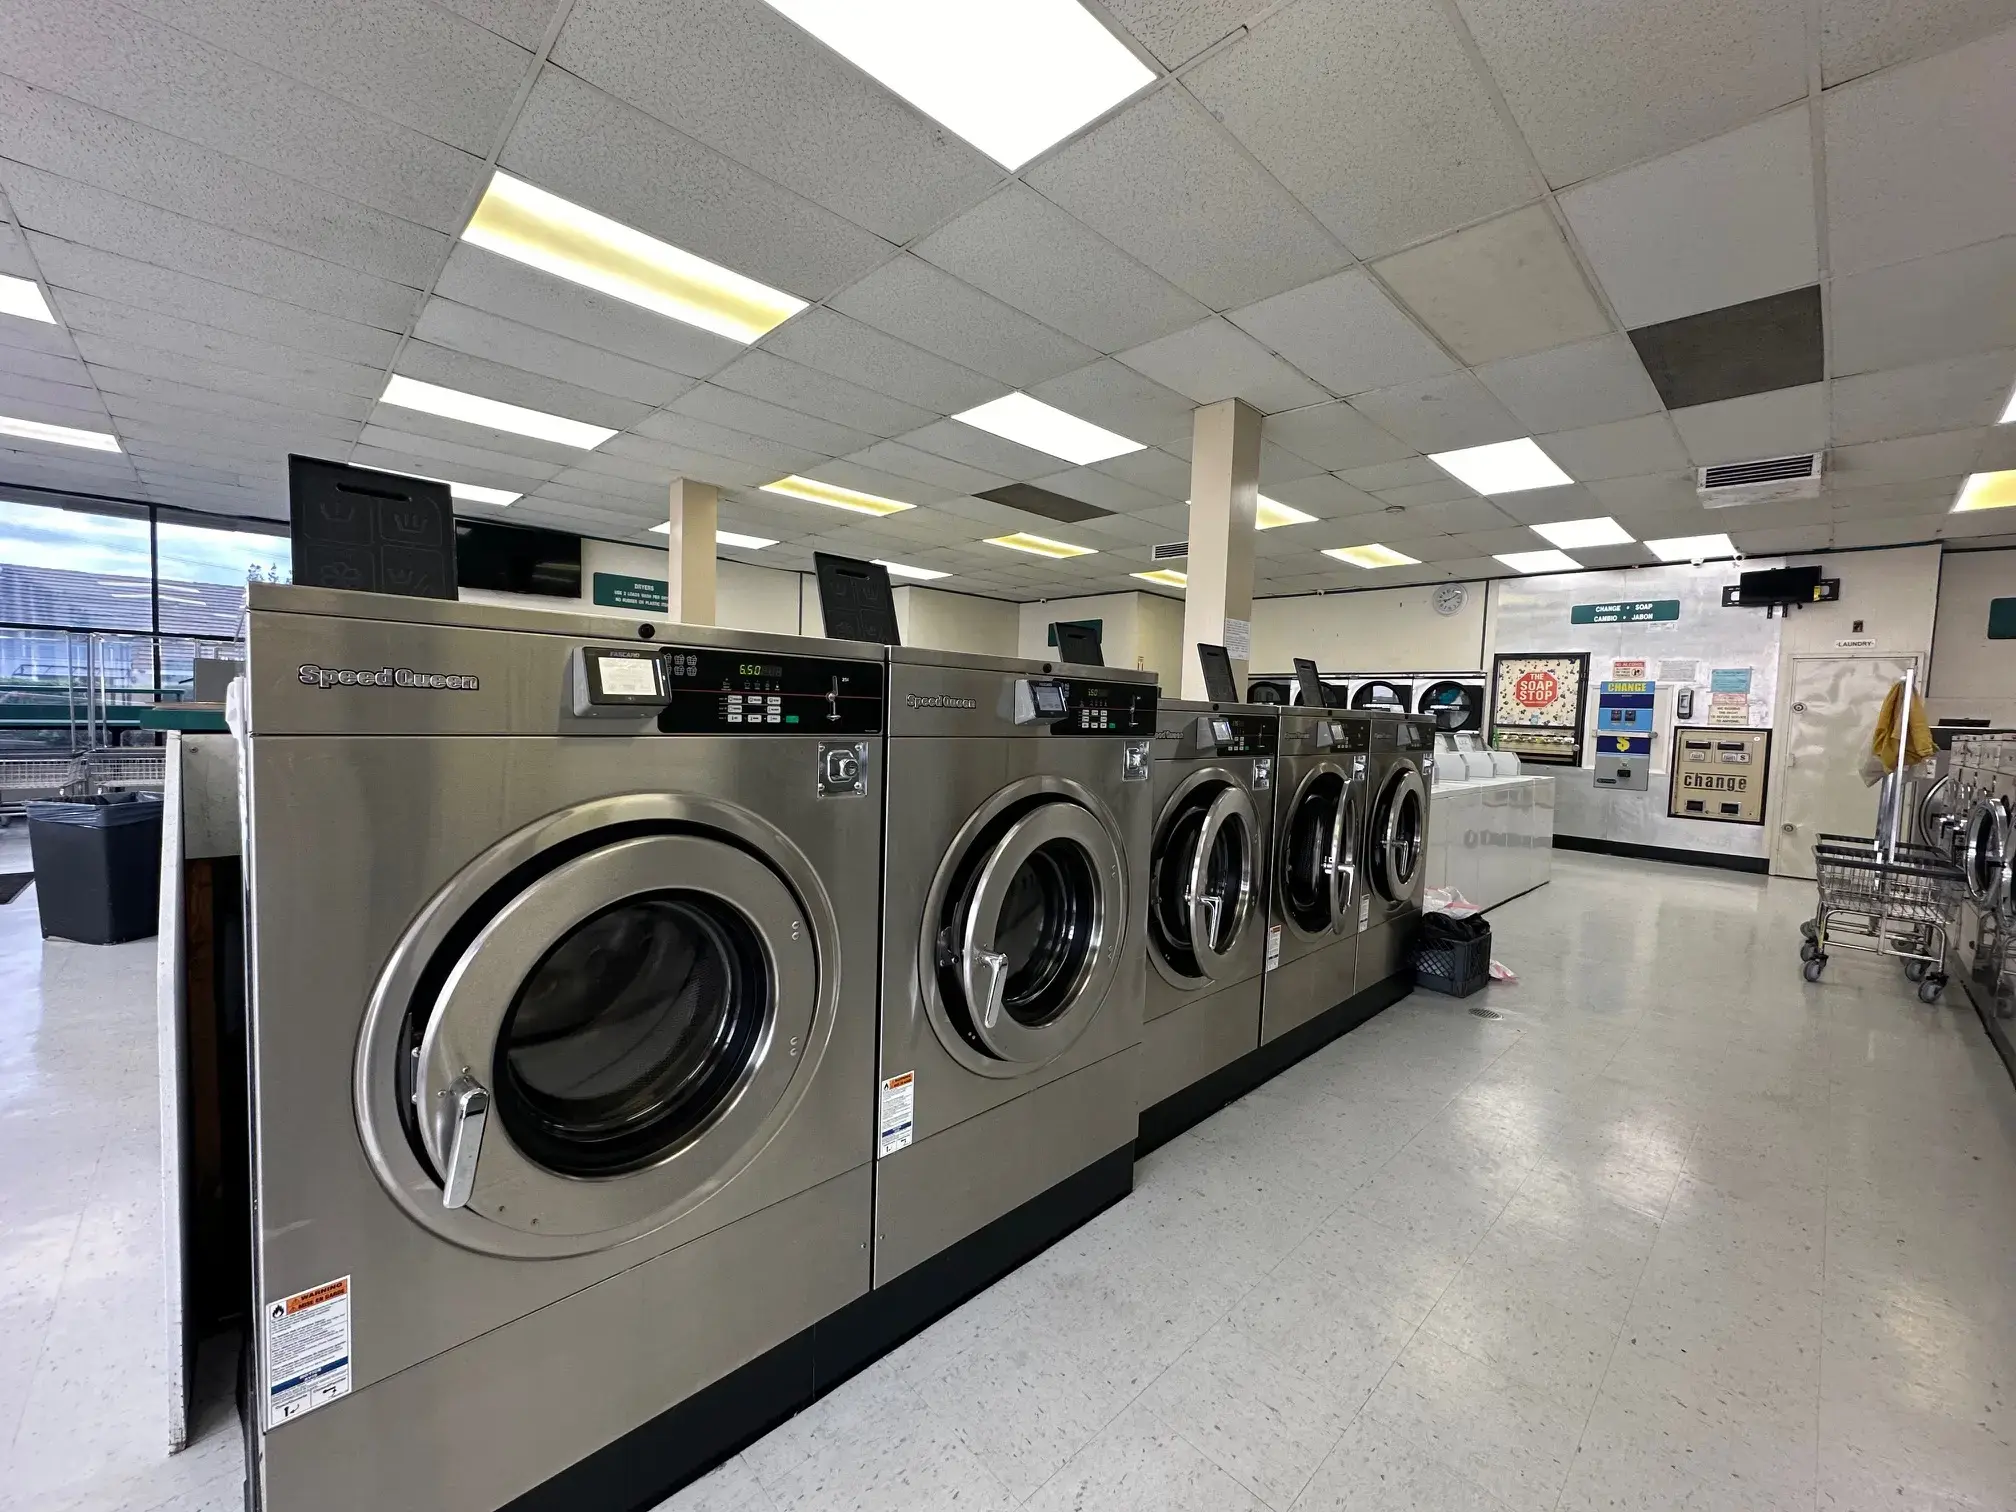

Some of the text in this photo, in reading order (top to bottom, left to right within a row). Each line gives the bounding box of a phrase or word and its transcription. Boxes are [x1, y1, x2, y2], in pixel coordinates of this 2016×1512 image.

[634, 584, 654, 592] DRYERS
[739, 664, 762, 676] 6.50
[298, 664, 479, 690] Speed Queen
[1520, 680, 1553, 690] SOAP
[1608, 683, 1647, 692] CHANGE
[907, 693, 976, 709] Speed Queen
[1520, 690, 1552, 700] STOP
[1684, 773, 1747, 791] change
[301, 1282, 342, 1300] WARNING
